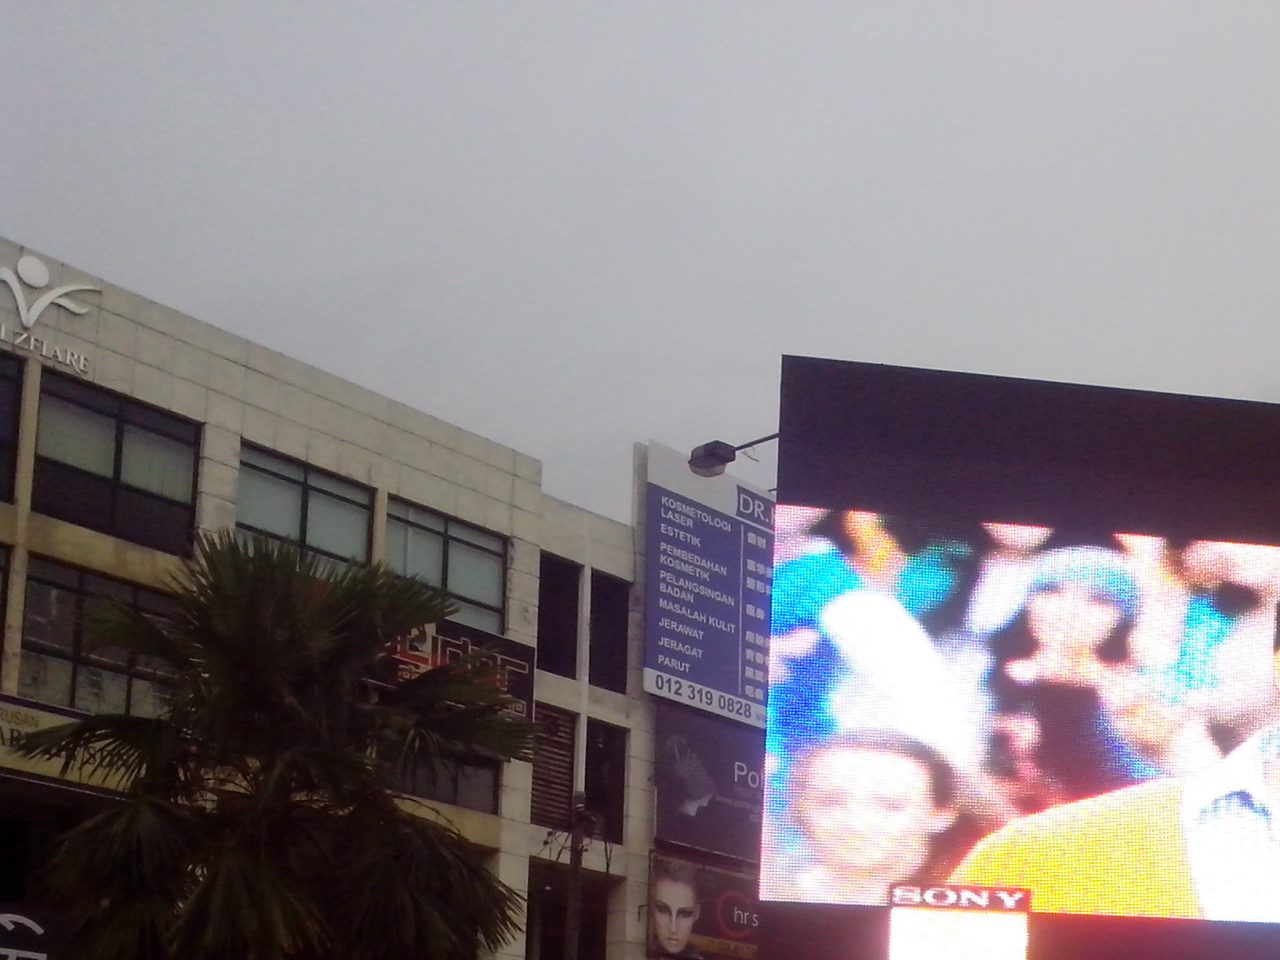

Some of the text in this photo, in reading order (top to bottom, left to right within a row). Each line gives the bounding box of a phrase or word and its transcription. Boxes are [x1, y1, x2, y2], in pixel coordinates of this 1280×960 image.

[661, 496, 731, 532] KOSMETOLOGI
[661, 508, 693, 528] LASER
[661, 524, 701, 547] ESTETIK
[660, 542, 727, 576] PEMBEDAHAN
[660, 555, 710, 581] KOSMETIK
[660, 570, 735, 606] PELANGSINGAN
[660, 582, 694, 603] BADAN
[660, 598, 736, 633] MASALAH KULIT
[658, 618, 704, 640] JERAWAT
[658, 636, 703, 659] JERAGAT
[658, 654, 691, 673] PARUT
[655, 674, 752, 719] 012 319 0828
[734, 761, 759, 788] Po
[892, 886, 1025, 909] SONY
